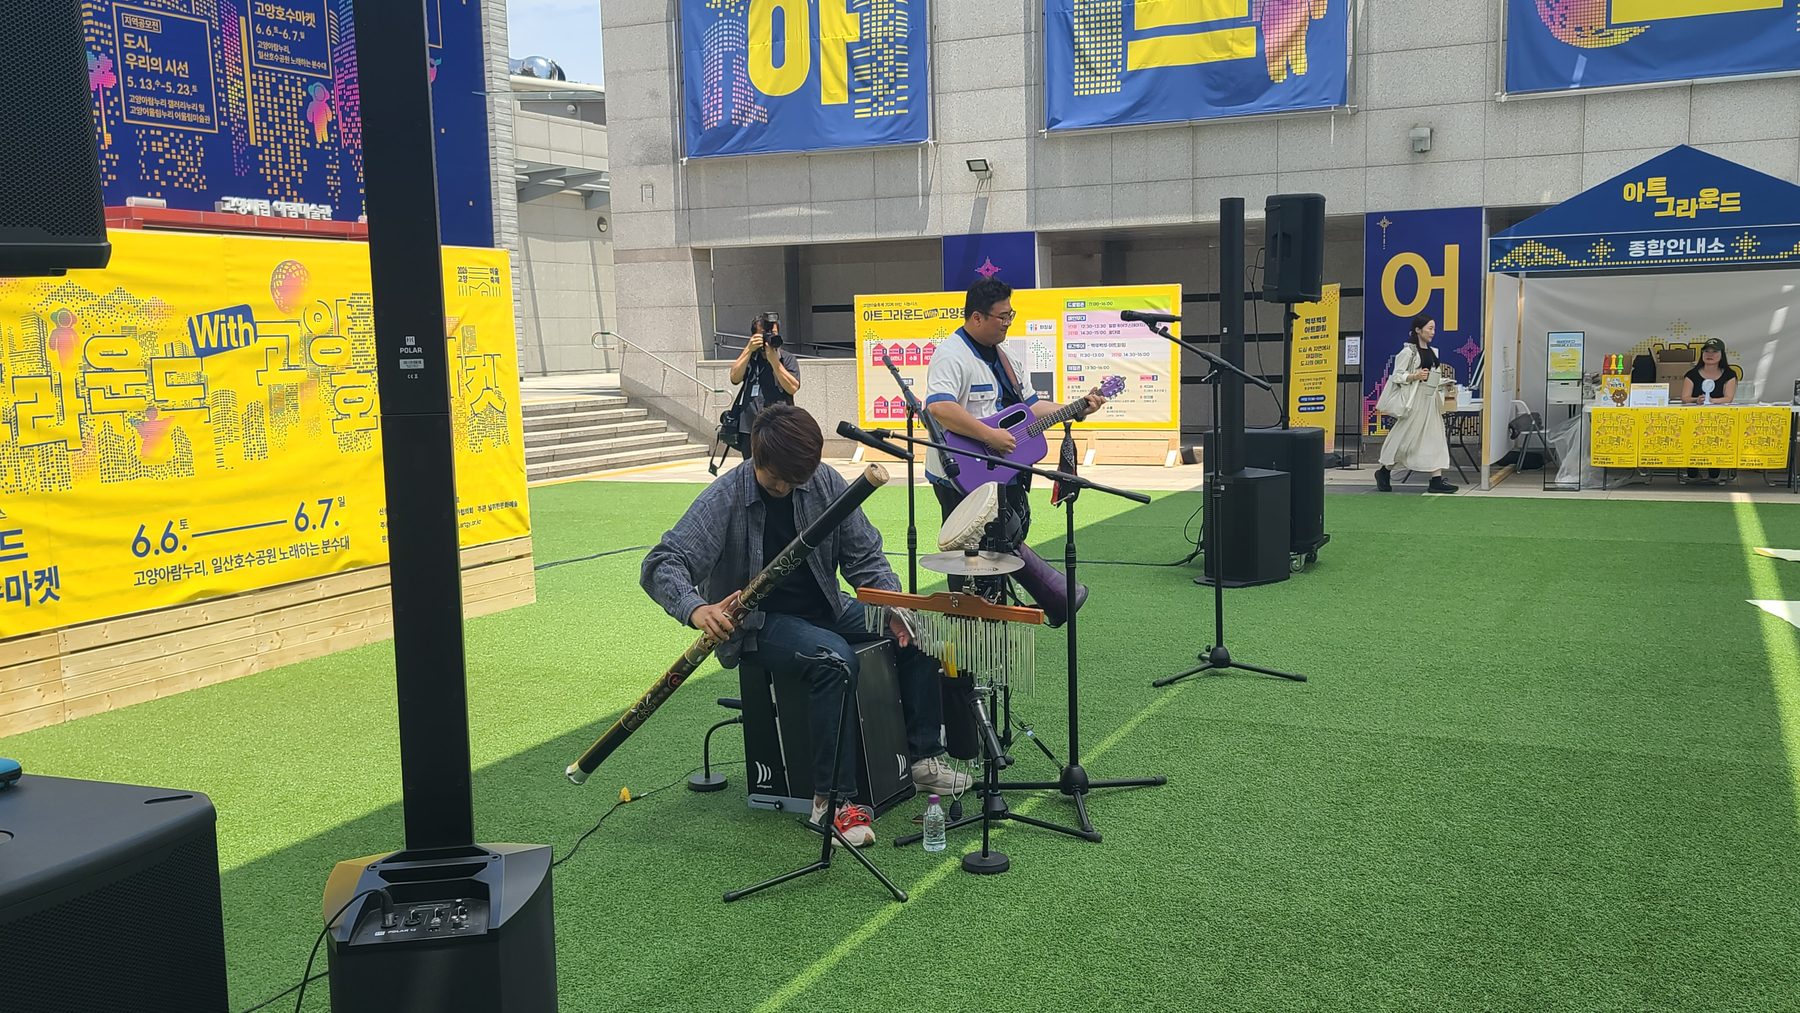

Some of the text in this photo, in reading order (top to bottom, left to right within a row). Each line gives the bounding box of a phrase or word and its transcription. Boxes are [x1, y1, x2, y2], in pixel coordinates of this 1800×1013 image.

[254, 1, 316, 28] 고양호수마켓
[123, 33, 152, 53] 도시,
[125, 53, 189, 78] 우리의 시선
[257, 50, 327, 70] 일산호수공원 노래하는 분수대
[128, 94, 167, 107] 고양아람누리
[1622, 176, 1667, 203] 아트
[1654, 187, 1742, 219] 그라운드
[1628, 237, 1726, 257] 종합안내소
[1380, 243, 1460, 332] 어
[863, 308, 923, 322] 아트그라운드
[192, 311, 256, 349] With
[133, 535, 350, 587] 고양아람누리, 일산호수공원 노래하는 분수대
[0, 565, 60, 607] 마켓
